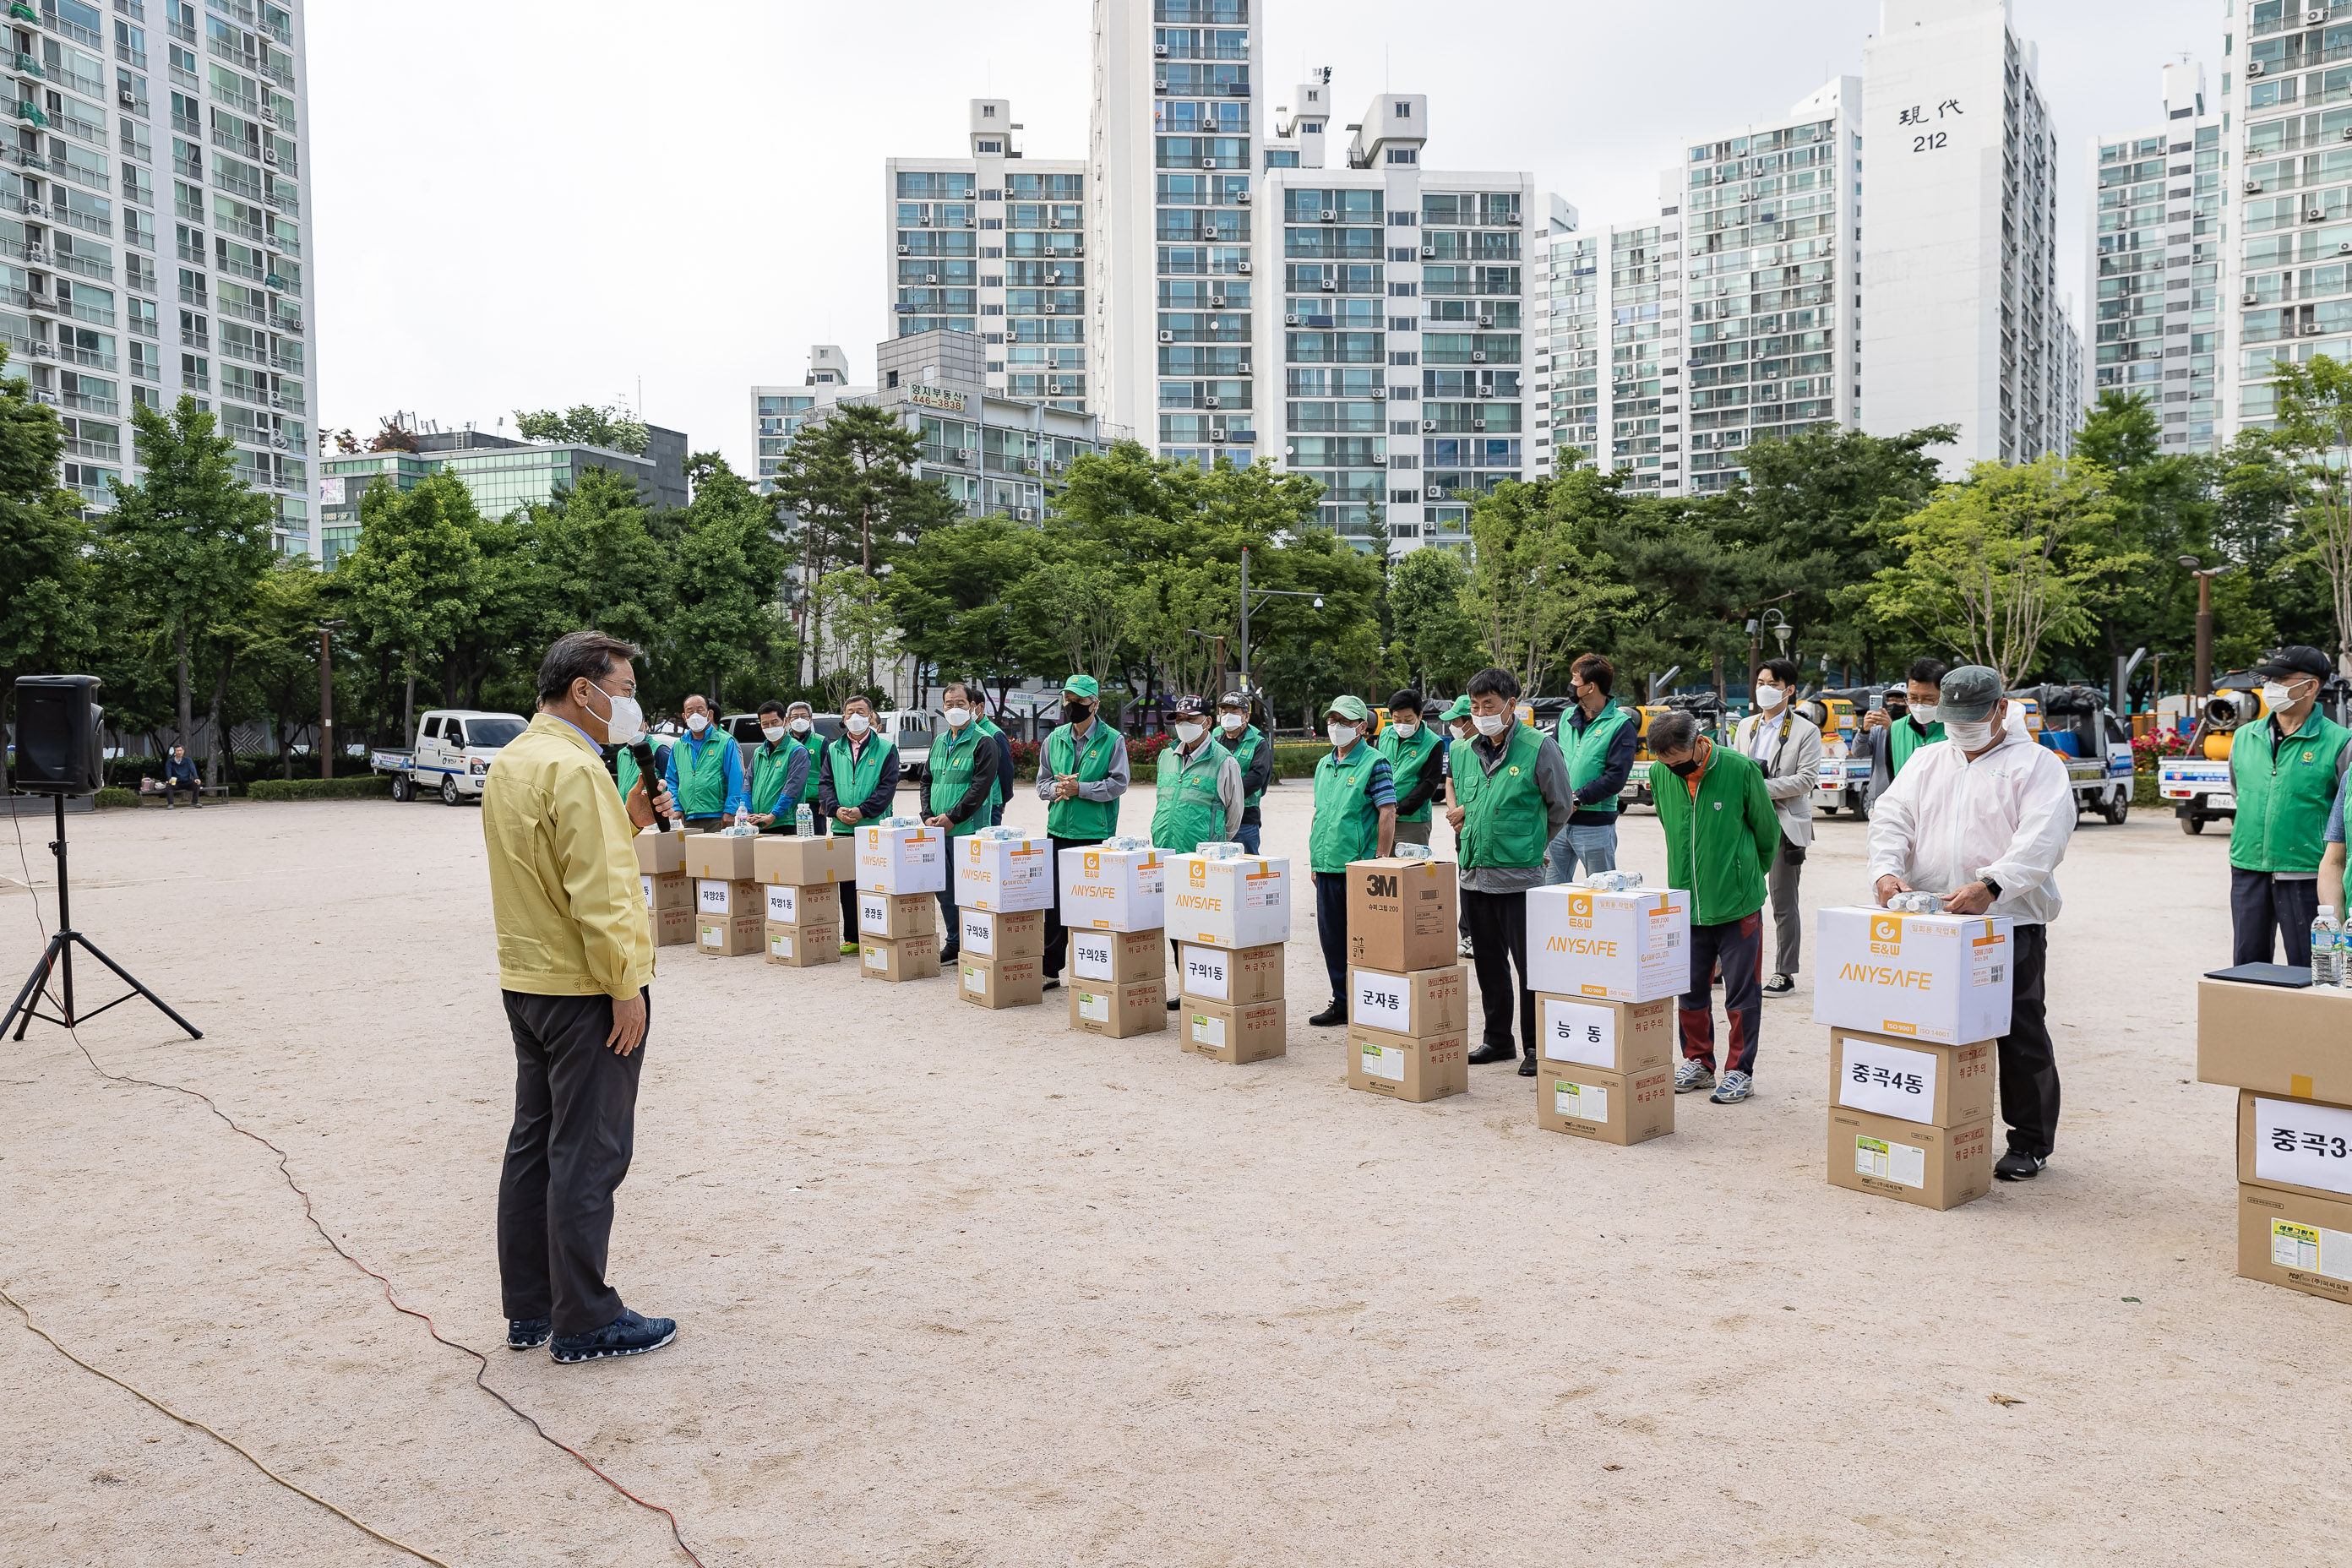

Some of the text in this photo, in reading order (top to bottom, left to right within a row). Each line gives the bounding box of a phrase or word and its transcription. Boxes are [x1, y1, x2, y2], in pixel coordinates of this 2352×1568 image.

[1914, 132, 1947, 153] 212
[912, 384, 961, 402] 양지부동산
[912, 395, 961, 410] 446-3838
[862, 855, 887, 868] ANYSAFE
[961, 868, 991, 883] ANYSAFE
[1084, 870, 1100, 879] E&W
[1190, 879, 1206, 889] E&W
[1366, 874, 1398, 898] 3M
[703, 890, 726, 902] 자양2동
[1070, 885, 1115, 899] ANYSAFE
[770, 897, 792, 910] 자양1동
[901, 905, 926, 913] 취급주의
[1175, 894, 1222, 912] ANYSAFE
[864, 907, 883, 920] 광장동
[1006, 924, 1034, 934] 취급주의
[1569, 917, 1592, 928] E&W
[966, 924, 989, 939] 구의3동
[808, 935, 831, 944] 취급주의
[1545, 935, 1618, 957] ANYSAFE
[906, 947, 932, 957] 취급주의
[1078, 947, 1108, 963] 구의2동
[1128, 943, 1156, 954] 취급주의
[1870, 942, 1900, 956] E&W
[1984, 947, 1994, 956] J100
[1189, 961, 1223, 981] 구의1동
[1244, 961, 1275, 972] 취급주의
[1004, 972, 1032, 982] 취급주의
[1839, 962, 1933, 990] ANYSAFE
[1363, 989, 1400, 1010] 군자동
[1429, 987, 1457, 999] 취급주의
[1129, 996, 1157, 1008] 취급주의
[1247, 1018, 1276, 1031] 취급주의
[1557, 1020, 1602, 1043] 능 동
[1635, 1017, 1663, 1032] 취급주의
[1898, 1024, 1914, 1032] 9001
[1431, 1050, 1459, 1064] 취급주의
[1852, 1062, 1925, 1095] 중곡4동
[1959, 1063, 1987, 1080] 취급주의
[1637, 1087, 1665, 1103] 취급주의
[2271, 1127, 2352, 1159] 중곡3
[1954, 1143, 1984, 1161] 취급주의
[2288, 1271, 2300, 1280] PCO
